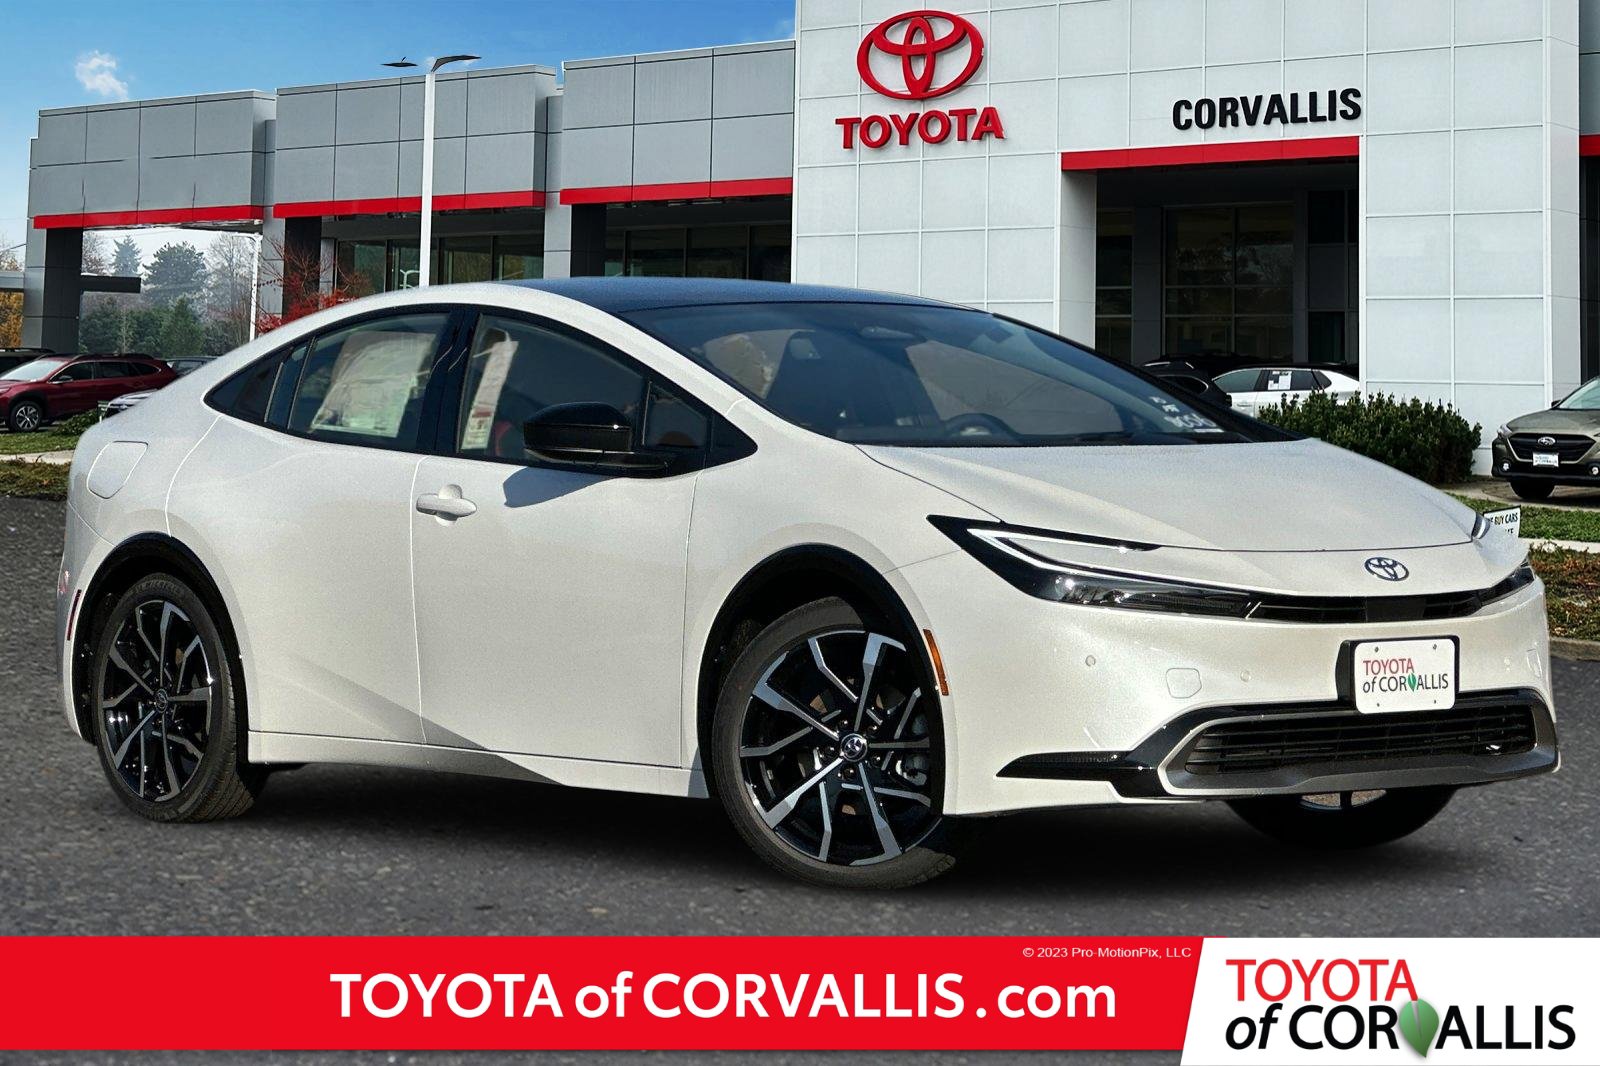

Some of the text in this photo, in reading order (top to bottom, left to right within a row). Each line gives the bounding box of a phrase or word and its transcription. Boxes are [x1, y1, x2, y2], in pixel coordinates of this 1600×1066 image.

[1172, 88, 1362, 131] CORVALLIS
[836, 106, 1005, 149] TOYOTA
[1494, 515, 1504, 525] BUY
[1505, 512, 1518, 524] CARS
[1362, 658, 1415, 676] TOYOTA
[1362, 676, 1377, 693] of
